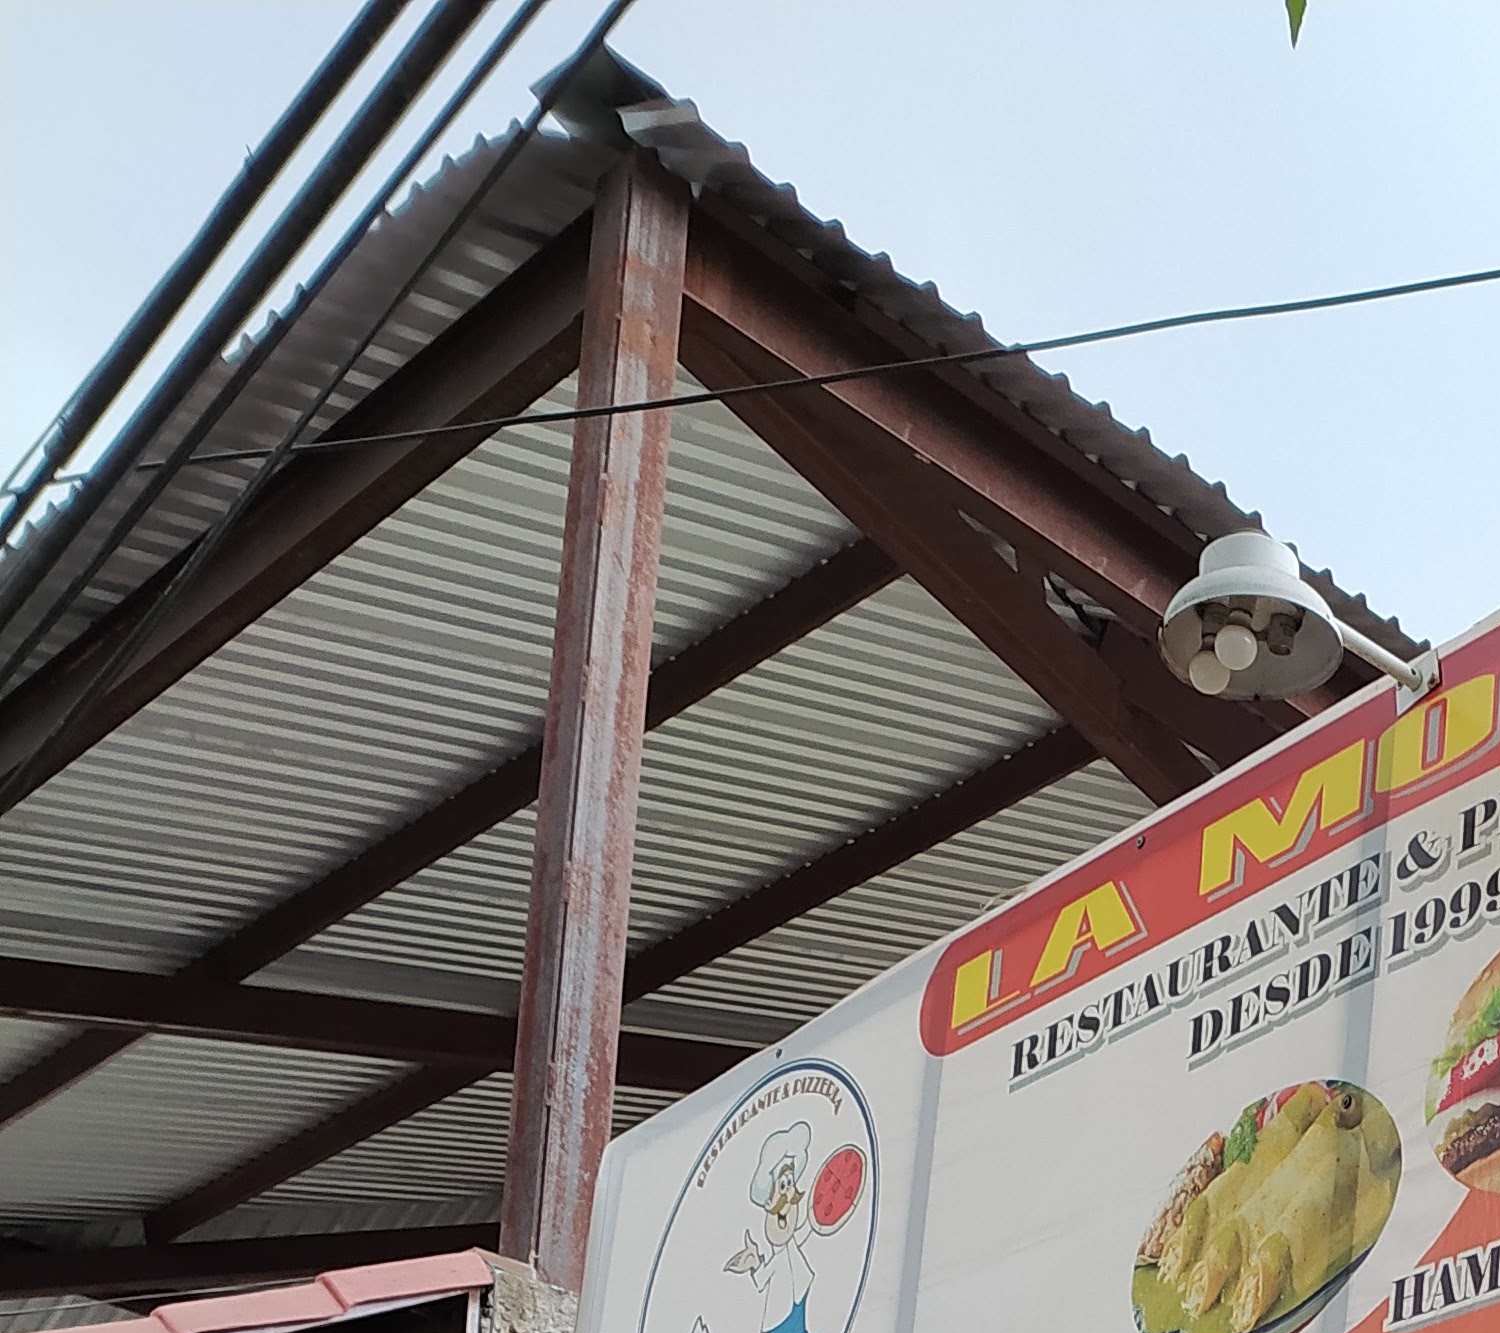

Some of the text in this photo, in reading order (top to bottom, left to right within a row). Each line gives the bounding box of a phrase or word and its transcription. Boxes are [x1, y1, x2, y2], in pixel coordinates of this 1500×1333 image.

[950, 883, 1137, 1028] LA
[1009, 852, 1382, 1080] RESTAURANTE
[1396, 829, 1446, 881] &
[1188, 926, 1376, 1062] DESDE
[697, 1088, 781, 1188] RESTAURANTE
[792, 1076, 843, 1116] PIZZERIA
